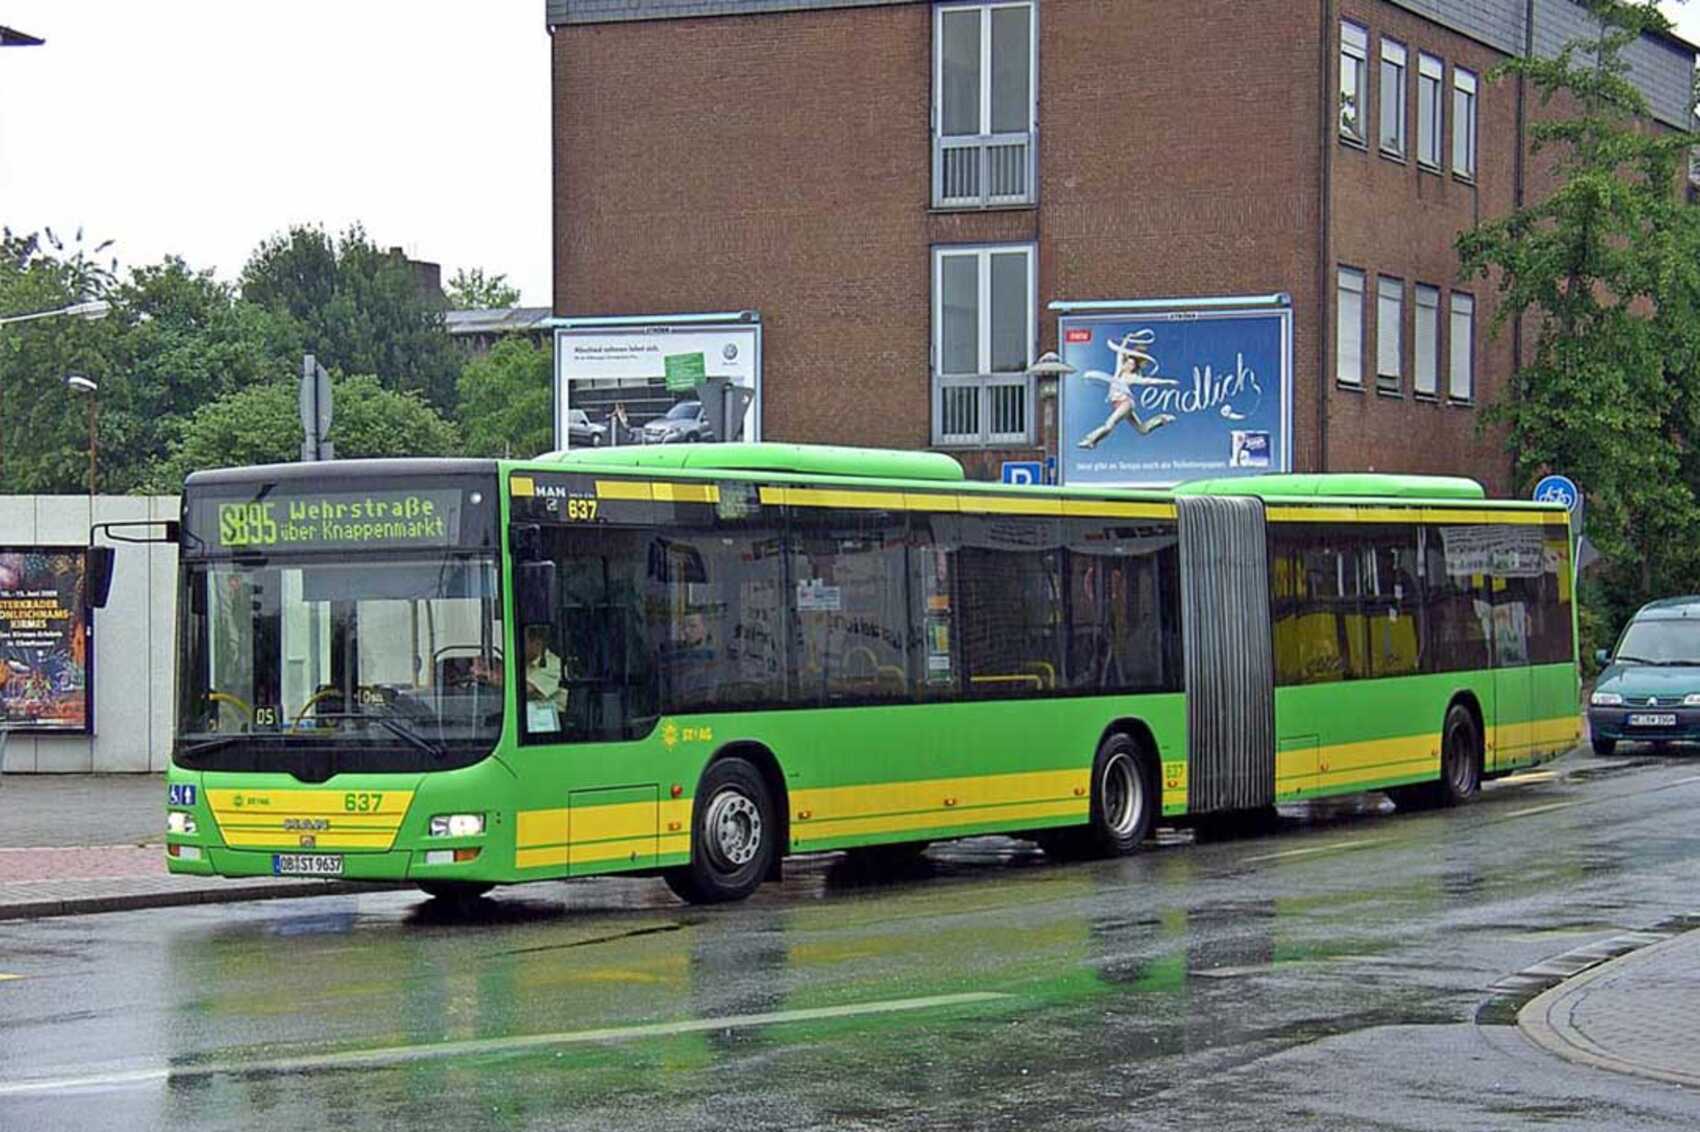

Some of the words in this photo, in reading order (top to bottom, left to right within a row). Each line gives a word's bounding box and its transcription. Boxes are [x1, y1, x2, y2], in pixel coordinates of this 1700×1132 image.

[536, 486, 565, 497] MAN
[290, 497, 433, 519] Wehrstraße
[568, 500, 597, 519] 637
[219, 503, 277, 545] SB95
[281, 523, 317, 541] über
[322, 516, 444, 541] Knappenmarkt
[344, 793, 382, 811] 637
[282, 856, 295, 871] OB
[300, 857, 314, 871] ST
[315, 857, 342, 871] 9637
